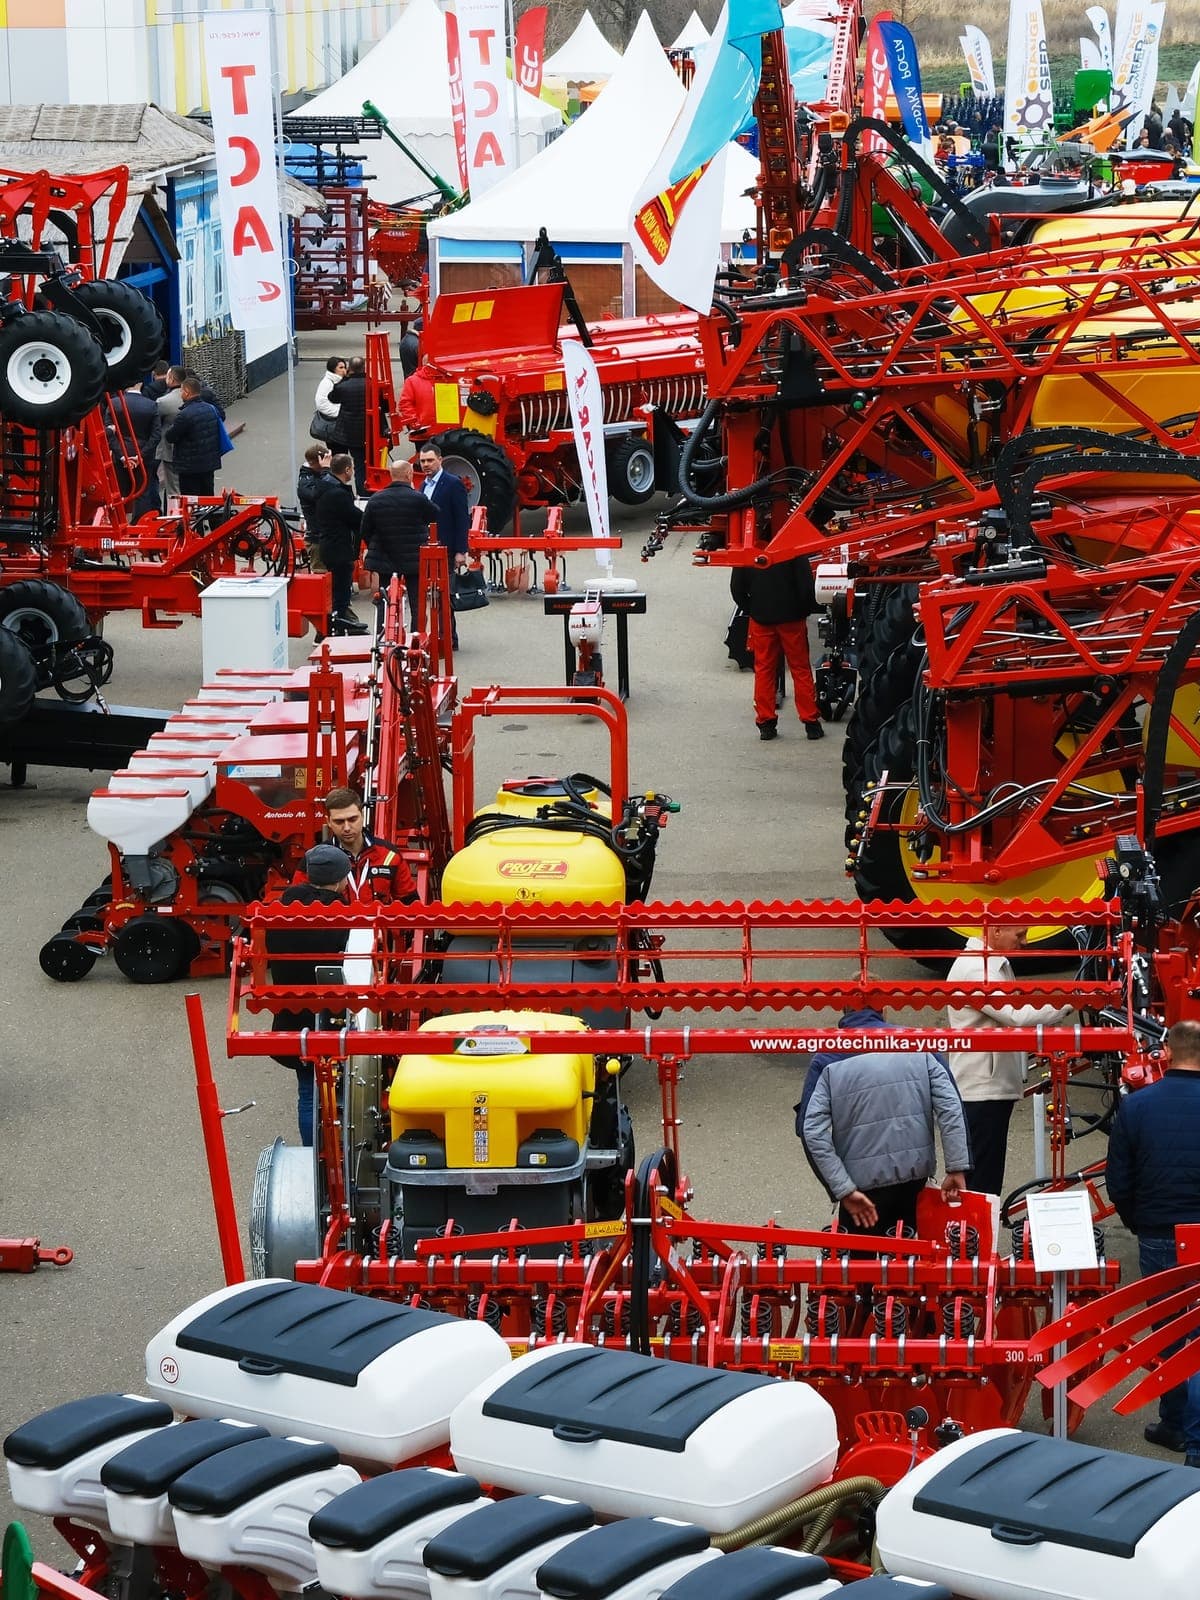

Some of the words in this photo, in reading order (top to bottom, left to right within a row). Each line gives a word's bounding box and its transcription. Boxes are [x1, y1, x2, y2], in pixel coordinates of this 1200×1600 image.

[264, 811, 294, 819] Antonio
[500, 860, 566, 875] PROJET
[750, 1036, 972, 1052] www.agrotechnika-yug.ru
[1005, 1350, 1024, 1363] 300
